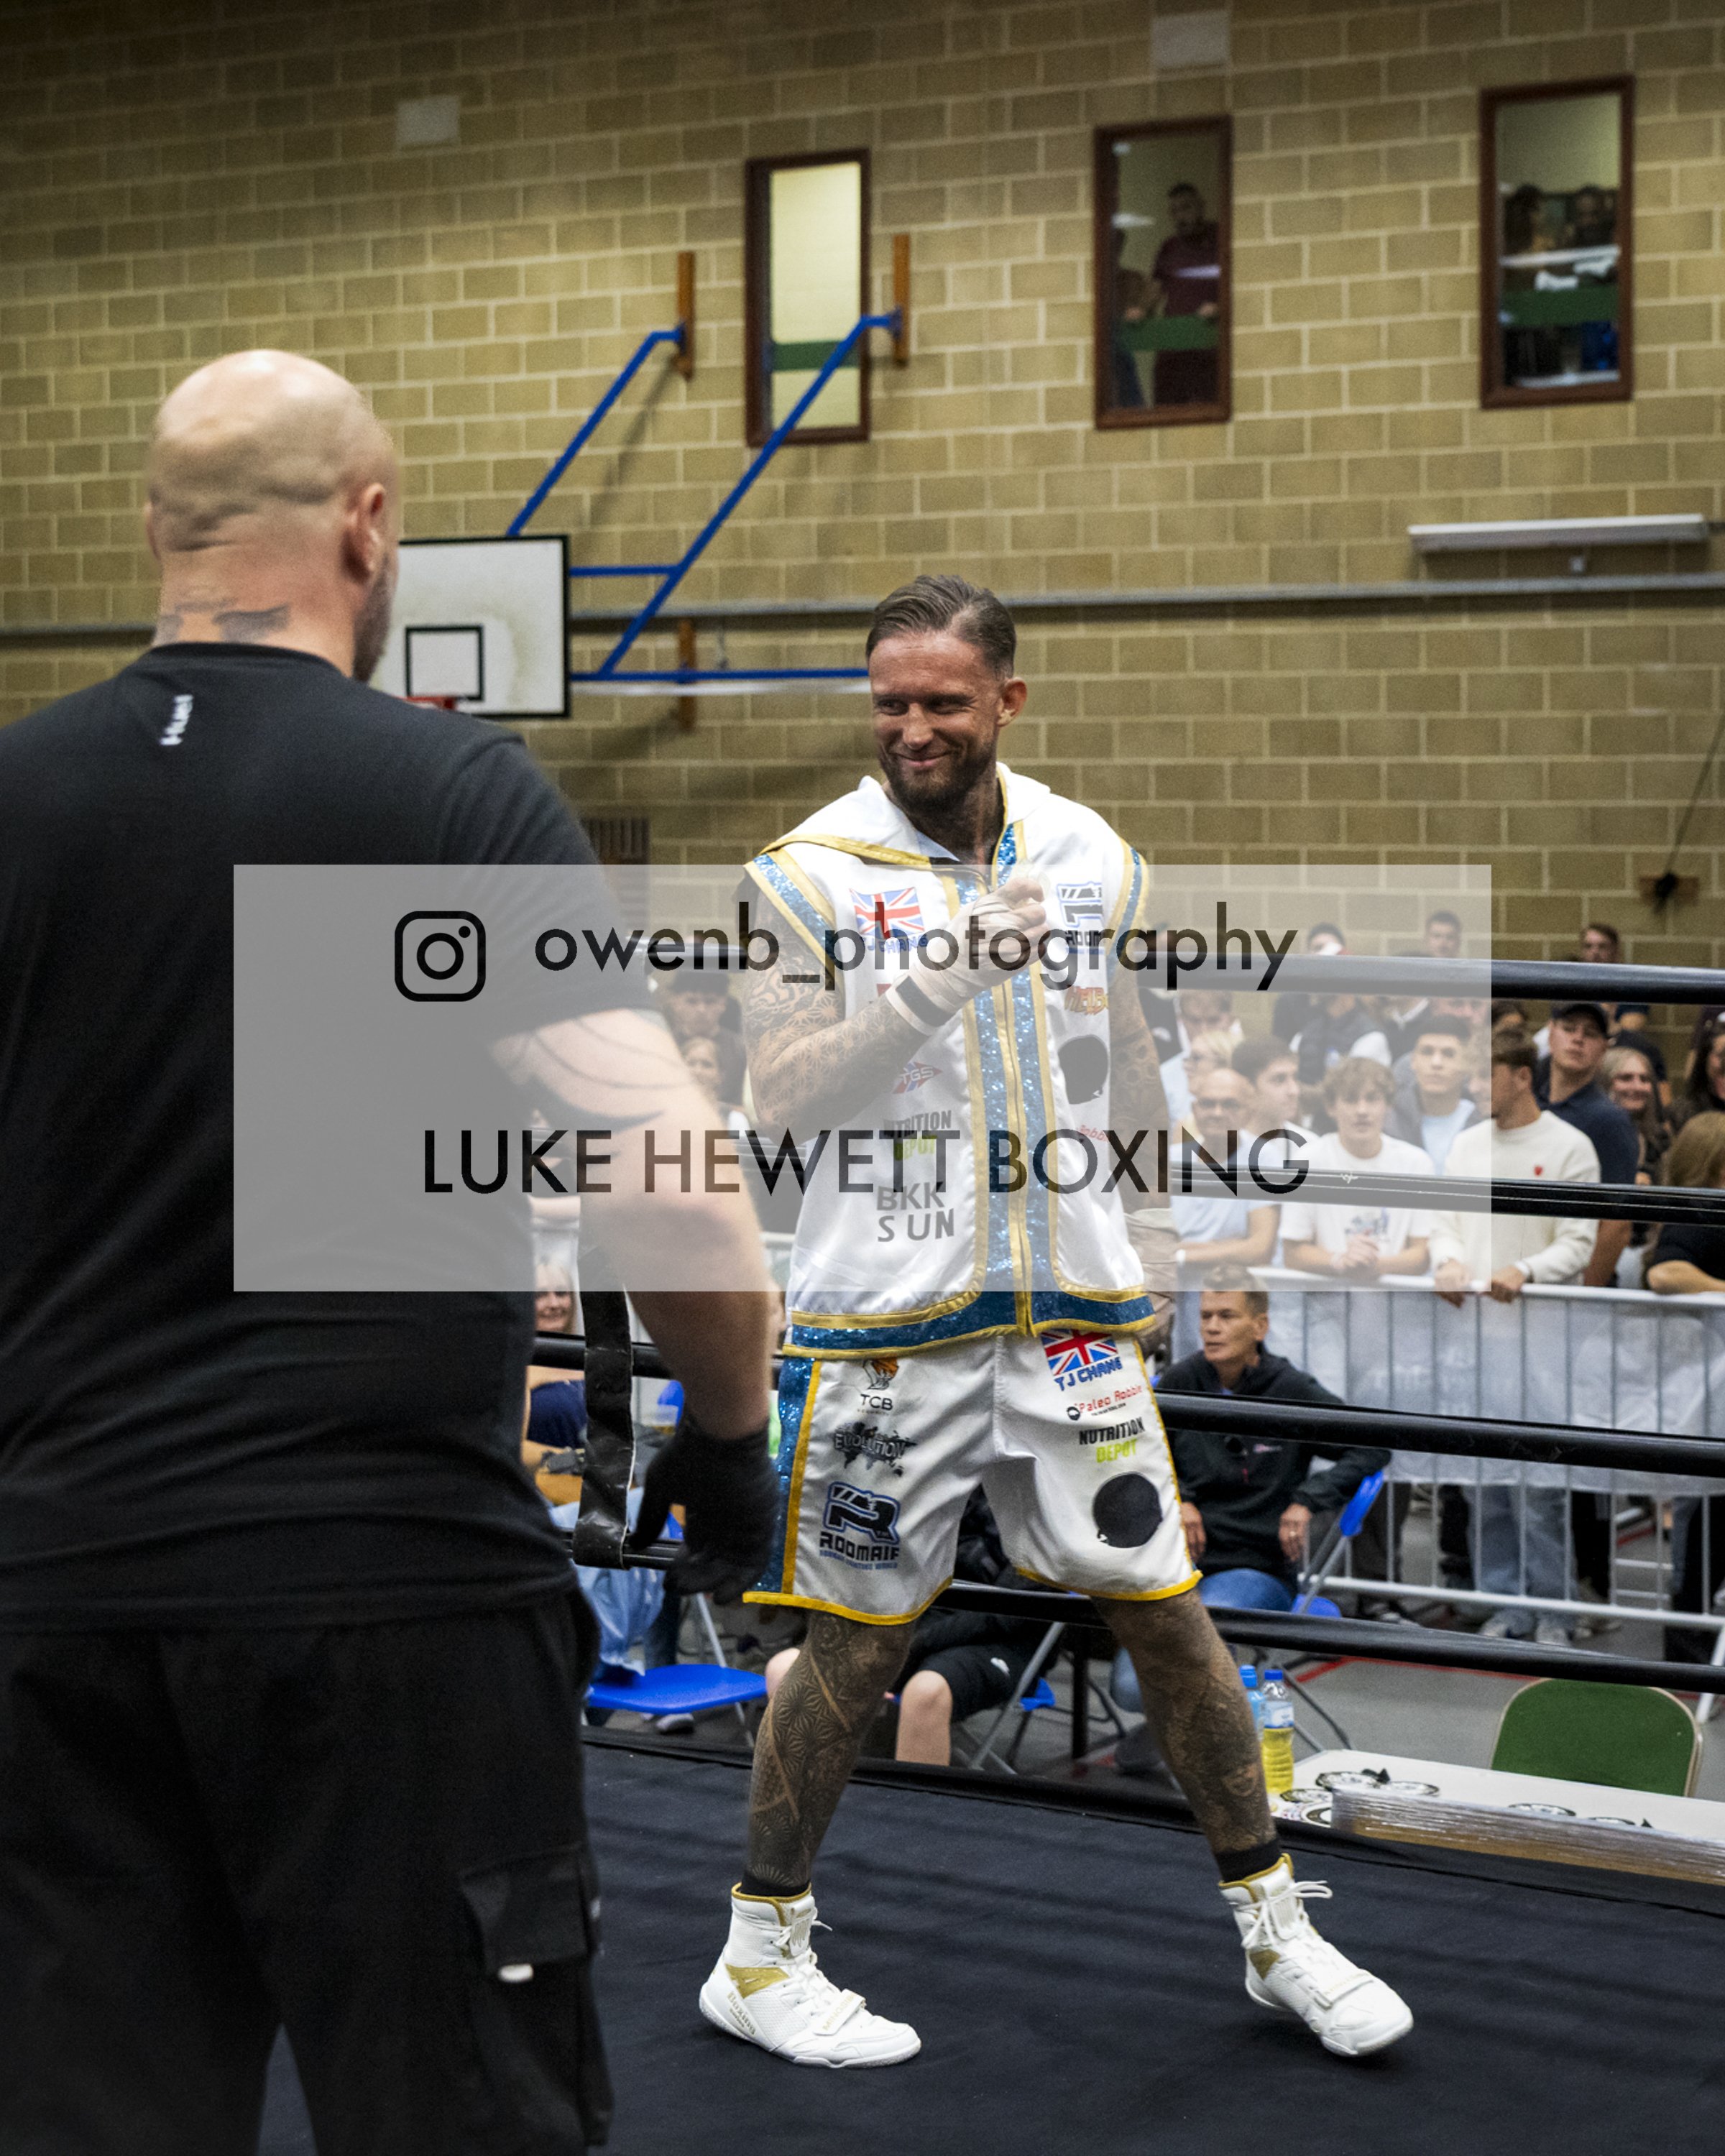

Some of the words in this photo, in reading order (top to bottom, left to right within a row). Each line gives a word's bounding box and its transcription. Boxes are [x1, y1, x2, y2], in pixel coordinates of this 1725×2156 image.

[876, 1181, 945, 1211] BKK
[878, 1208, 954, 1242] SUN
[1054, 1372, 1077, 1392] TJ
[860, 1393, 894, 1411] TCB
[1079, 1416, 1146, 1445] NUTRITION
[834, 1432, 906, 1460] EVOLUTION
[1096, 1437, 1138, 1463] DEPOT
[820, 1531, 900, 1562] ROOMAIF
